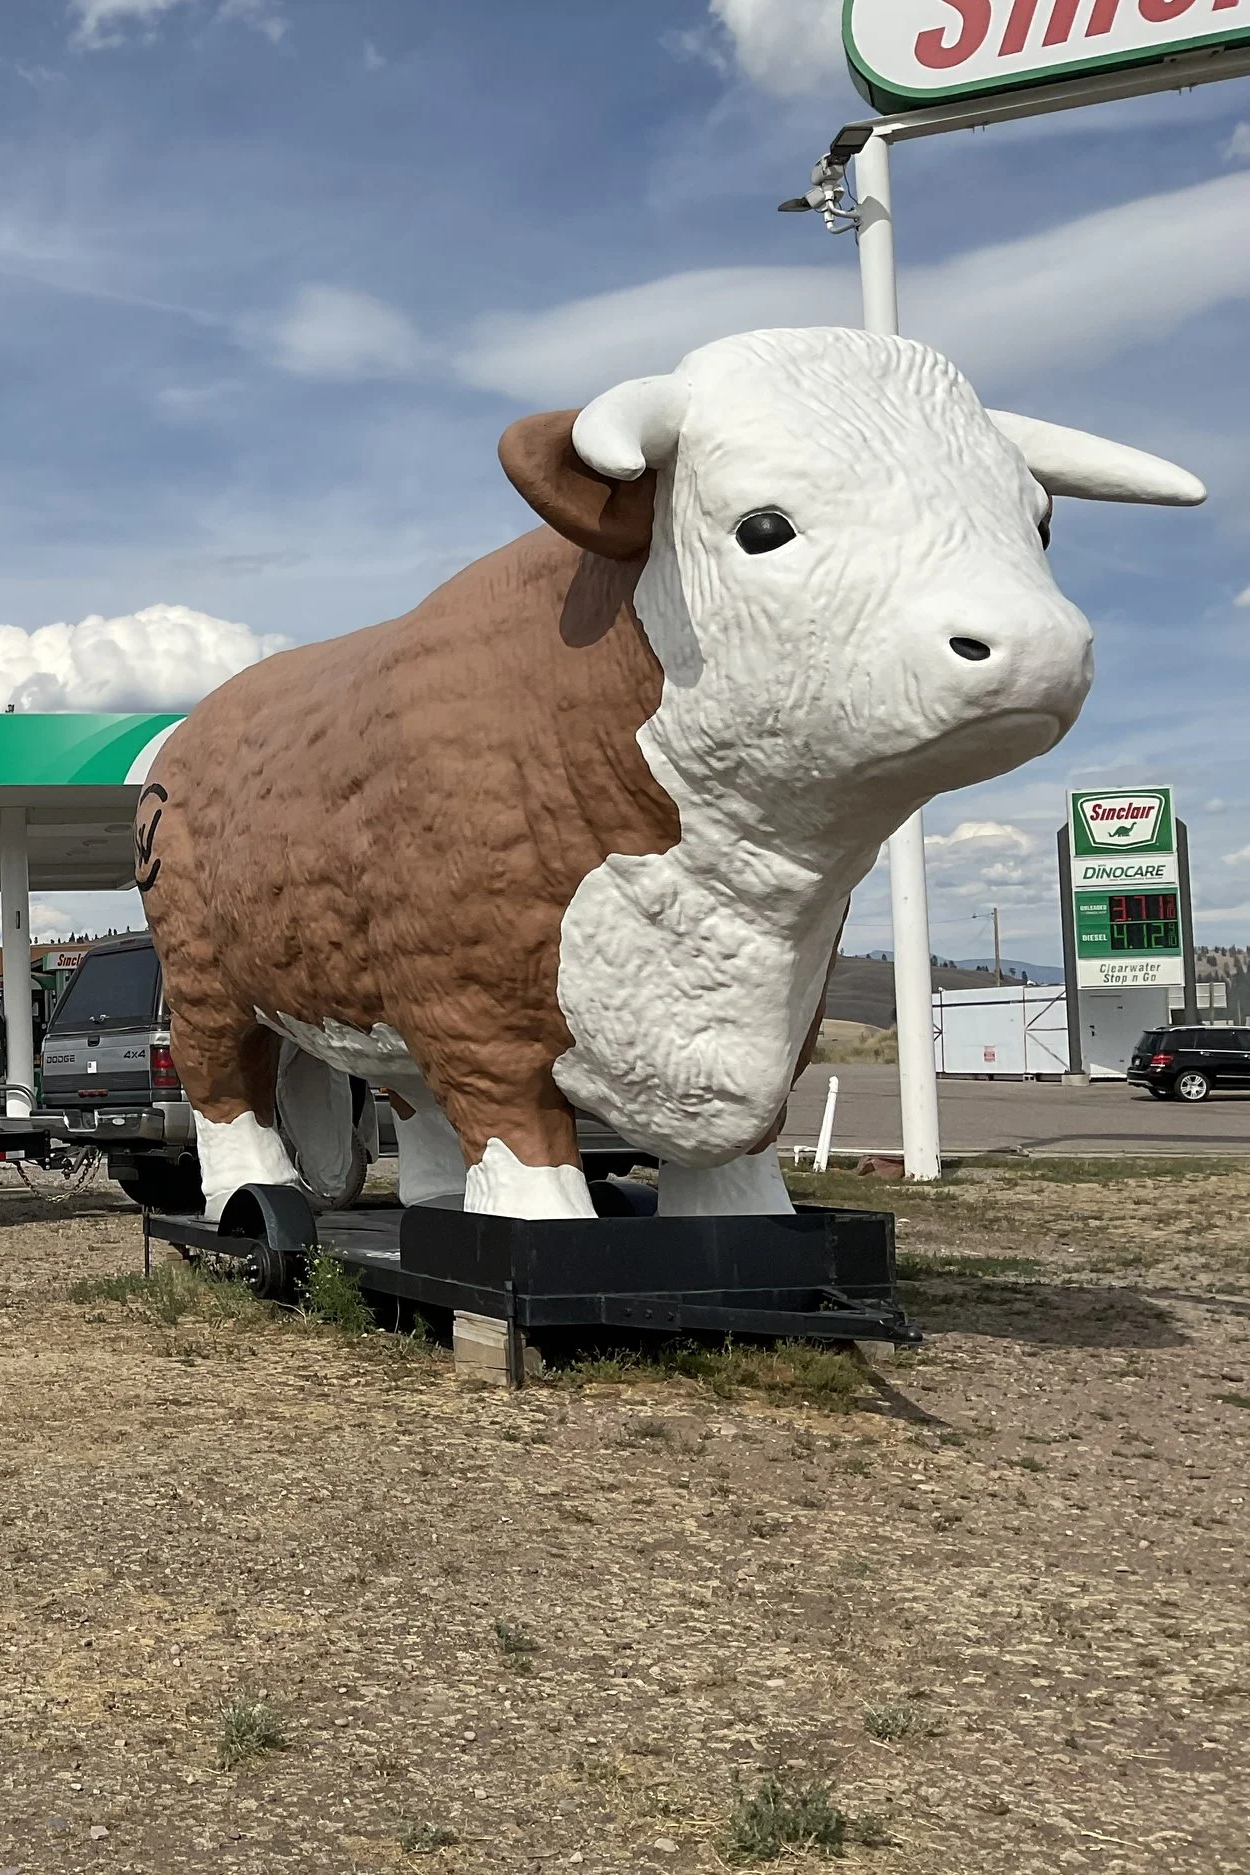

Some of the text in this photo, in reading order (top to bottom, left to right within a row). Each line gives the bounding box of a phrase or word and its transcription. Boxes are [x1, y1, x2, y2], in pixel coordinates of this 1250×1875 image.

[914, 0, 1238, 69] Sin
[1090, 802, 1155, 821] Sinclair
[1082, 864, 1166, 880] DINOCARE
[1099, 962, 1161, 973] Clearwater
[1103, 973, 1127, 984] Stop
[1143, 973, 1156, 982] Go
[46, 1055, 75, 1064] DODGE
